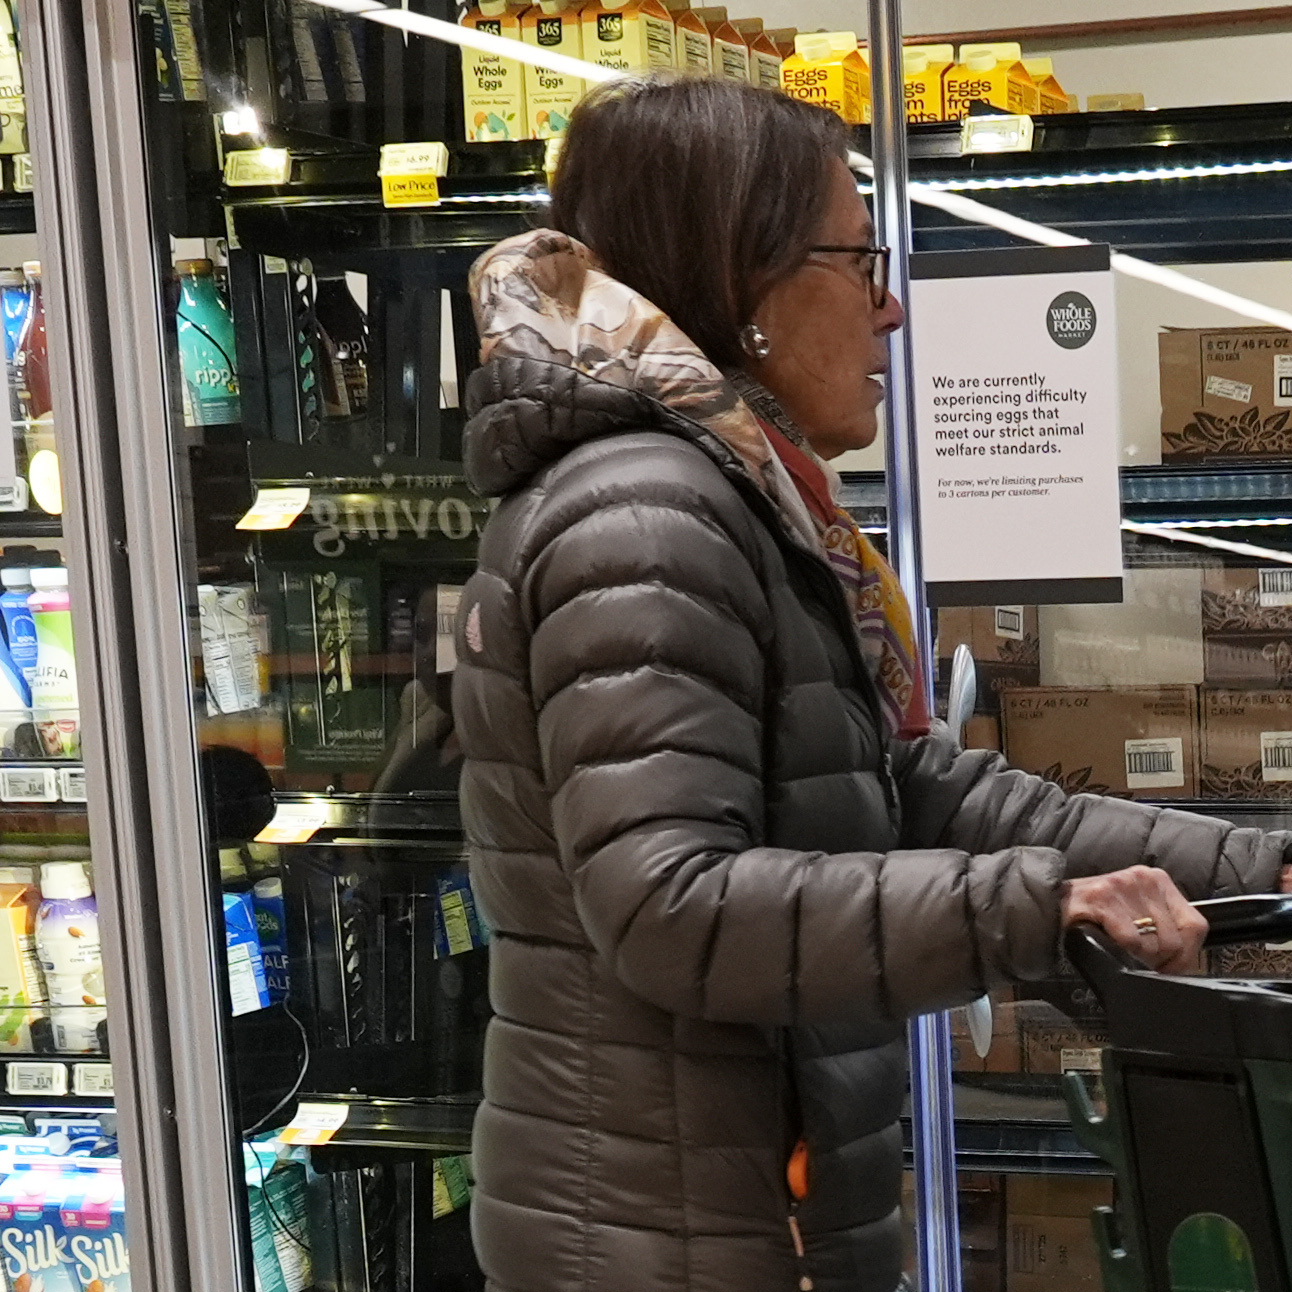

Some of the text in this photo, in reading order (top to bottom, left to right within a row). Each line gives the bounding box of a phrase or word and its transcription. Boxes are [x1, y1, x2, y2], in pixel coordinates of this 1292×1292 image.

[539, 23, 560, 37] 365
[599, 18, 621, 32] 365
[479, 56, 500, 64] Liquid
[473, 66, 507, 76] Whole
[783, 68, 828, 86] Eggs
[478, 77, 502, 90] Eggs
[539, 75, 564, 88] Eggs
[947, 80, 991, 97] Eggs
[388, 180, 435, 191] Low Price
[1051, 304, 1092, 320] WHOLE
[1054, 320, 1091, 332] FOODS
[1217, 340, 1231, 349] CT
[1258, 340, 1270, 349] FL
[1274, 339, 1289, 348] OZ
[932, 373, 1045, 388] We are currently
[934, 389, 1087, 408] experiencing difficulty
[934, 407, 1059, 424] sourcing eggs that
[935, 422, 1083, 439] meet our strict animal
[936, 441, 1061, 456] welfare standards.
[938, 475, 1083, 487] For now, we're limiting purchases
[938, 488, 1050, 499] to 3 cartons per customer.
[2, 1224, 62, 1279] Silk
